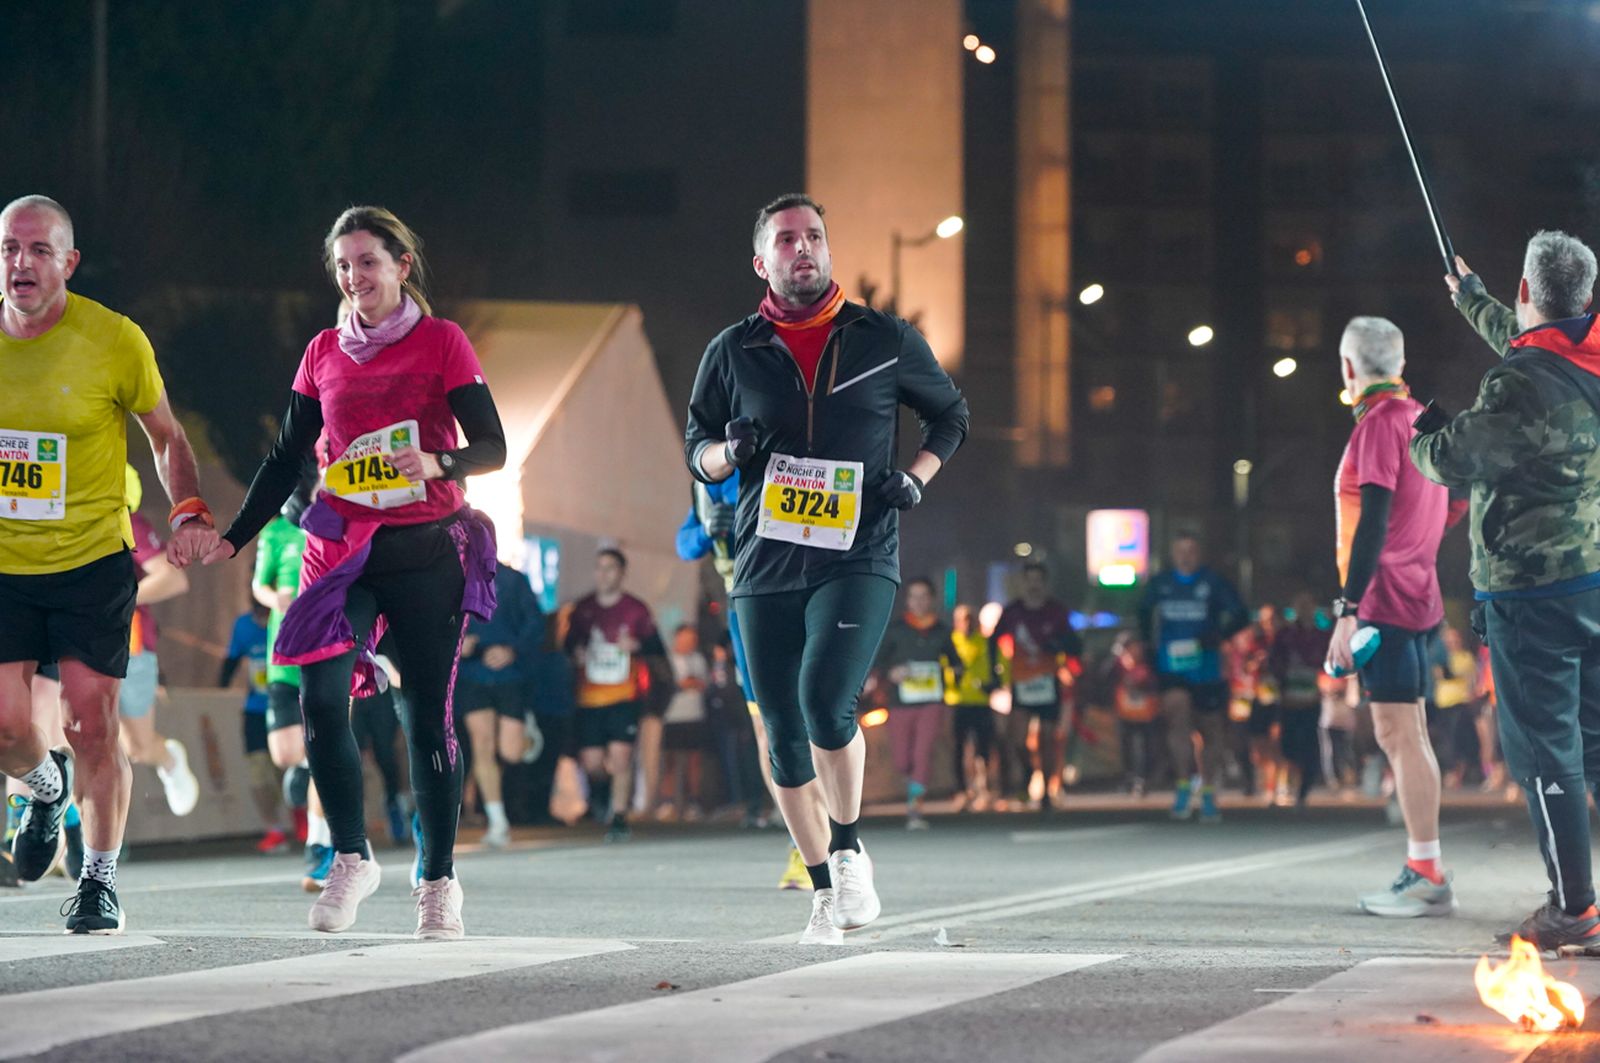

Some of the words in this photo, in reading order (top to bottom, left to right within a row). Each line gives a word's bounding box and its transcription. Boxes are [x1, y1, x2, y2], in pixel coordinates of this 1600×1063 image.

[18, 440, 29, 450] DE
[786, 465, 813, 477] NOCHE
[815, 469, 826, 479] DE
[773, 474, 793, 486] SAN
[780, 487, 839, 519] 3724
